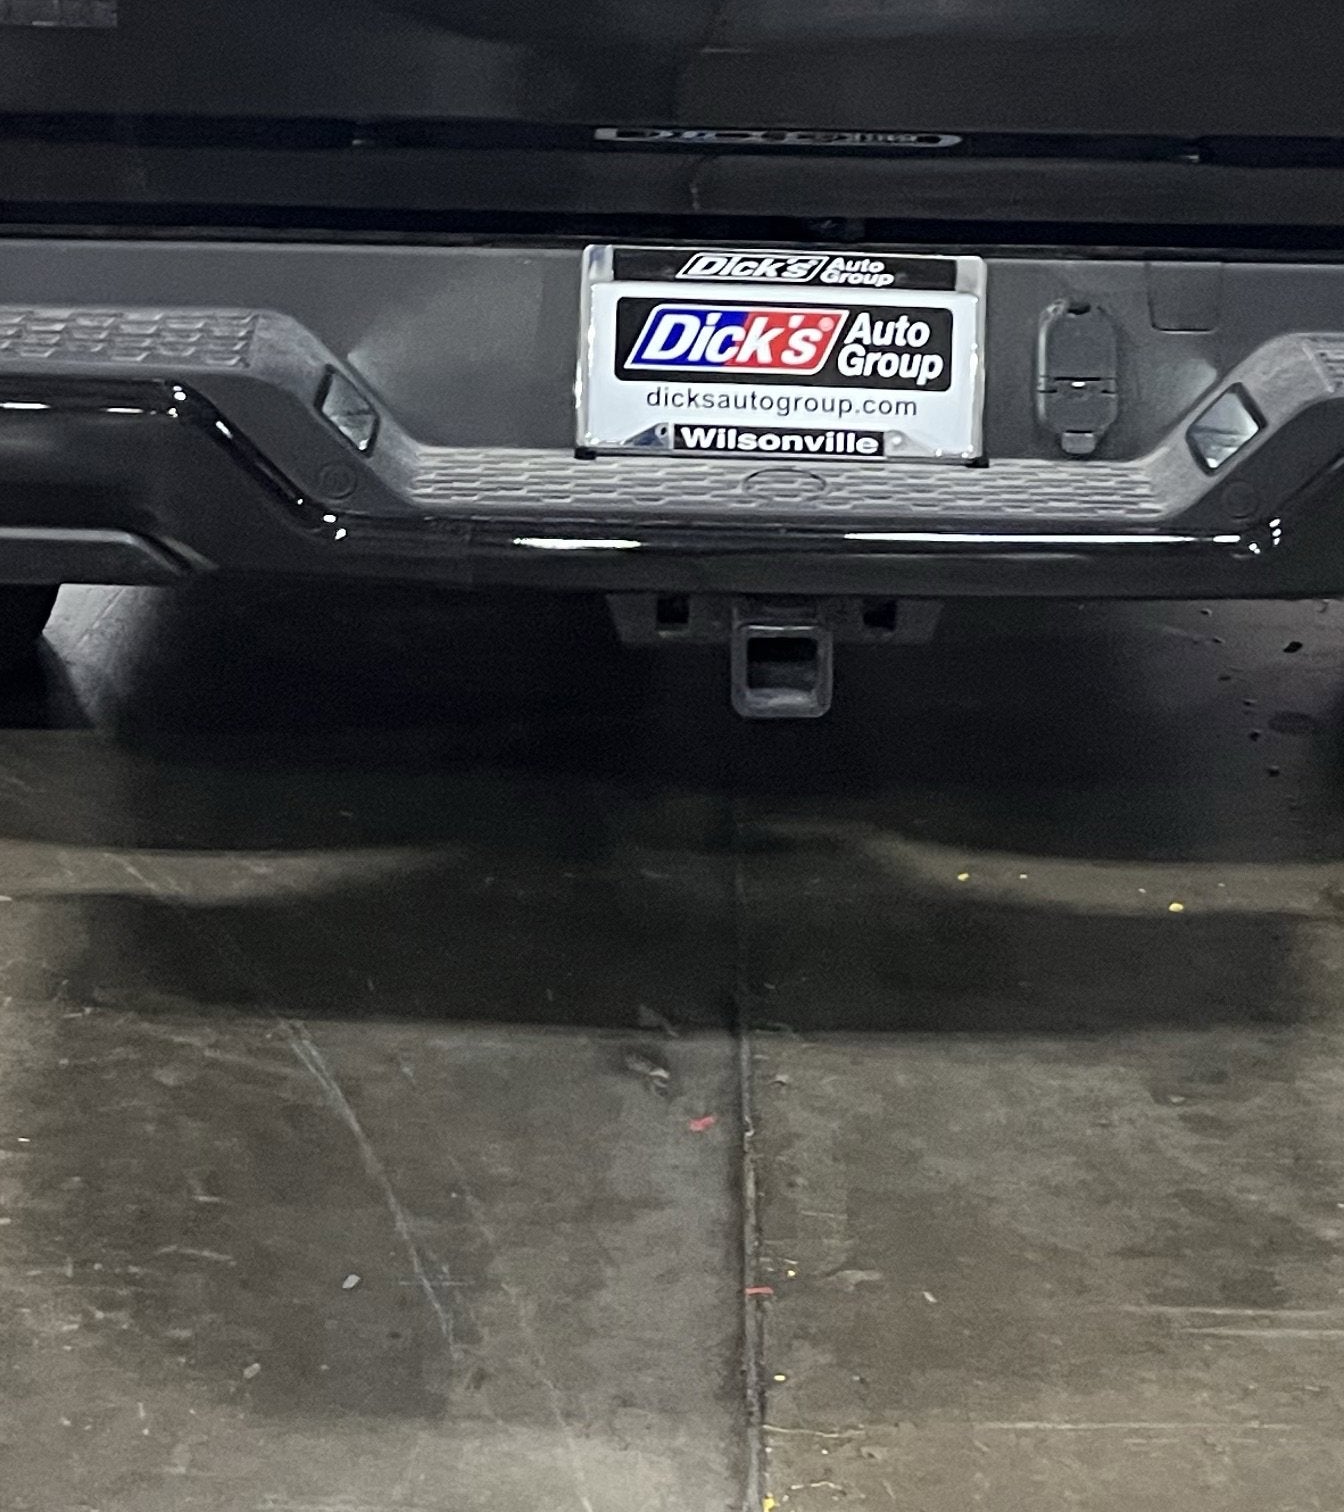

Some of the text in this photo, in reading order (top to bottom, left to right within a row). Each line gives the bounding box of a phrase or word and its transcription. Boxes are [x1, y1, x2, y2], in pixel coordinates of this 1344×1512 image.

[819, 269, 896, 288] Group
[830, 256, 886, 274] Auto
[640, 312, 932, 366] Dick's Auto
[836, 348, 945, 387] Group
[646, 386, 918, 417] dicksautogroup.com
[679, 425, 879, 456] Wilsonville
